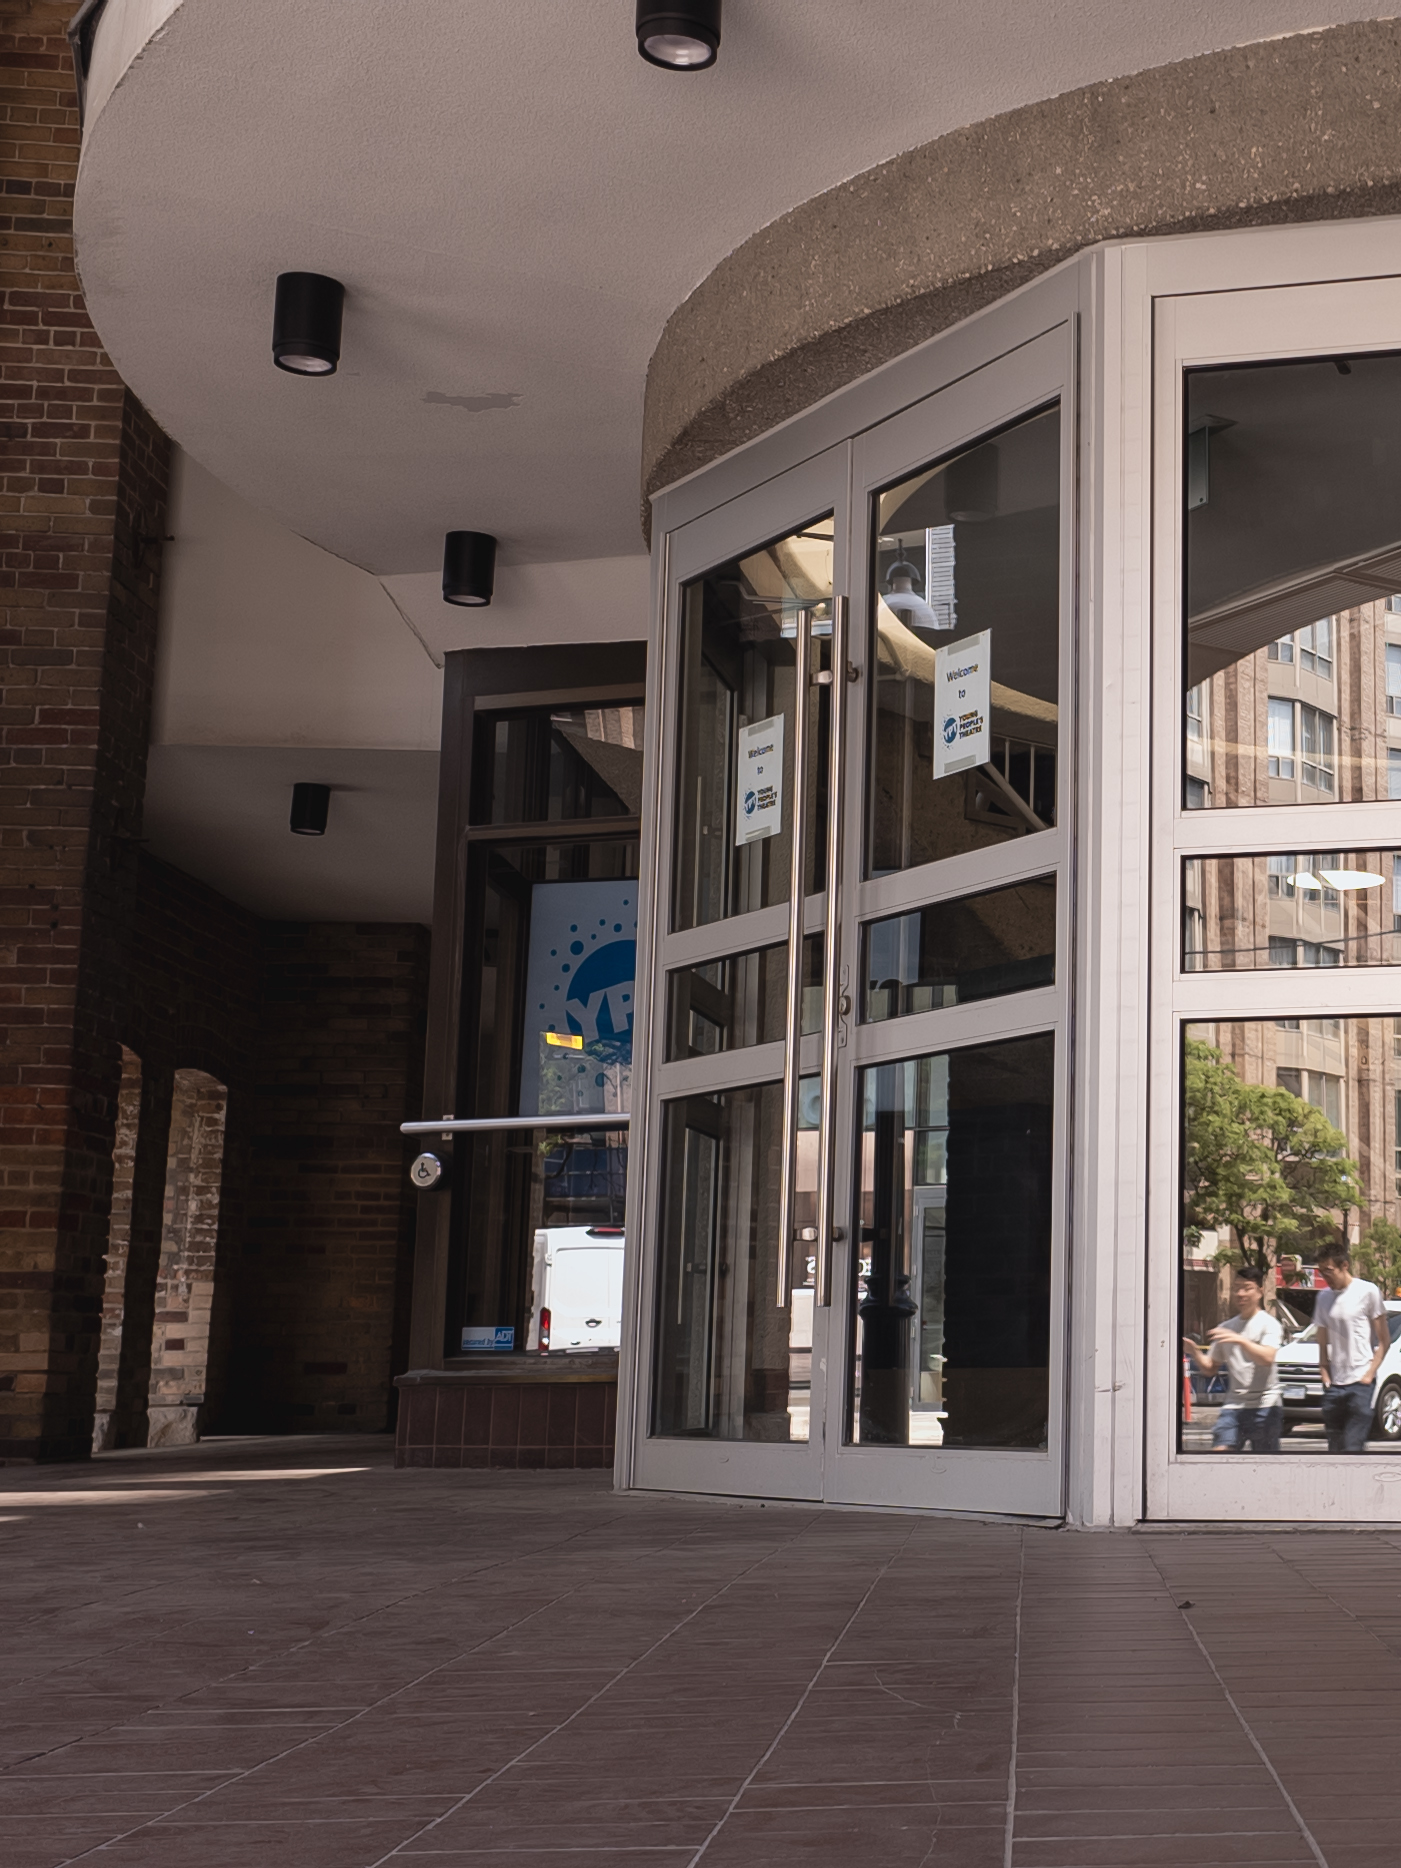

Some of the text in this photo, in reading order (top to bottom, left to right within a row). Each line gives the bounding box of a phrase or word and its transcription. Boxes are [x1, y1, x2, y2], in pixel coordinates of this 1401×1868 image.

[946, 664, 978, 682] Welcome
[959, 690, 965, 699] to
[496, 1331, 513, 1341] ADT
